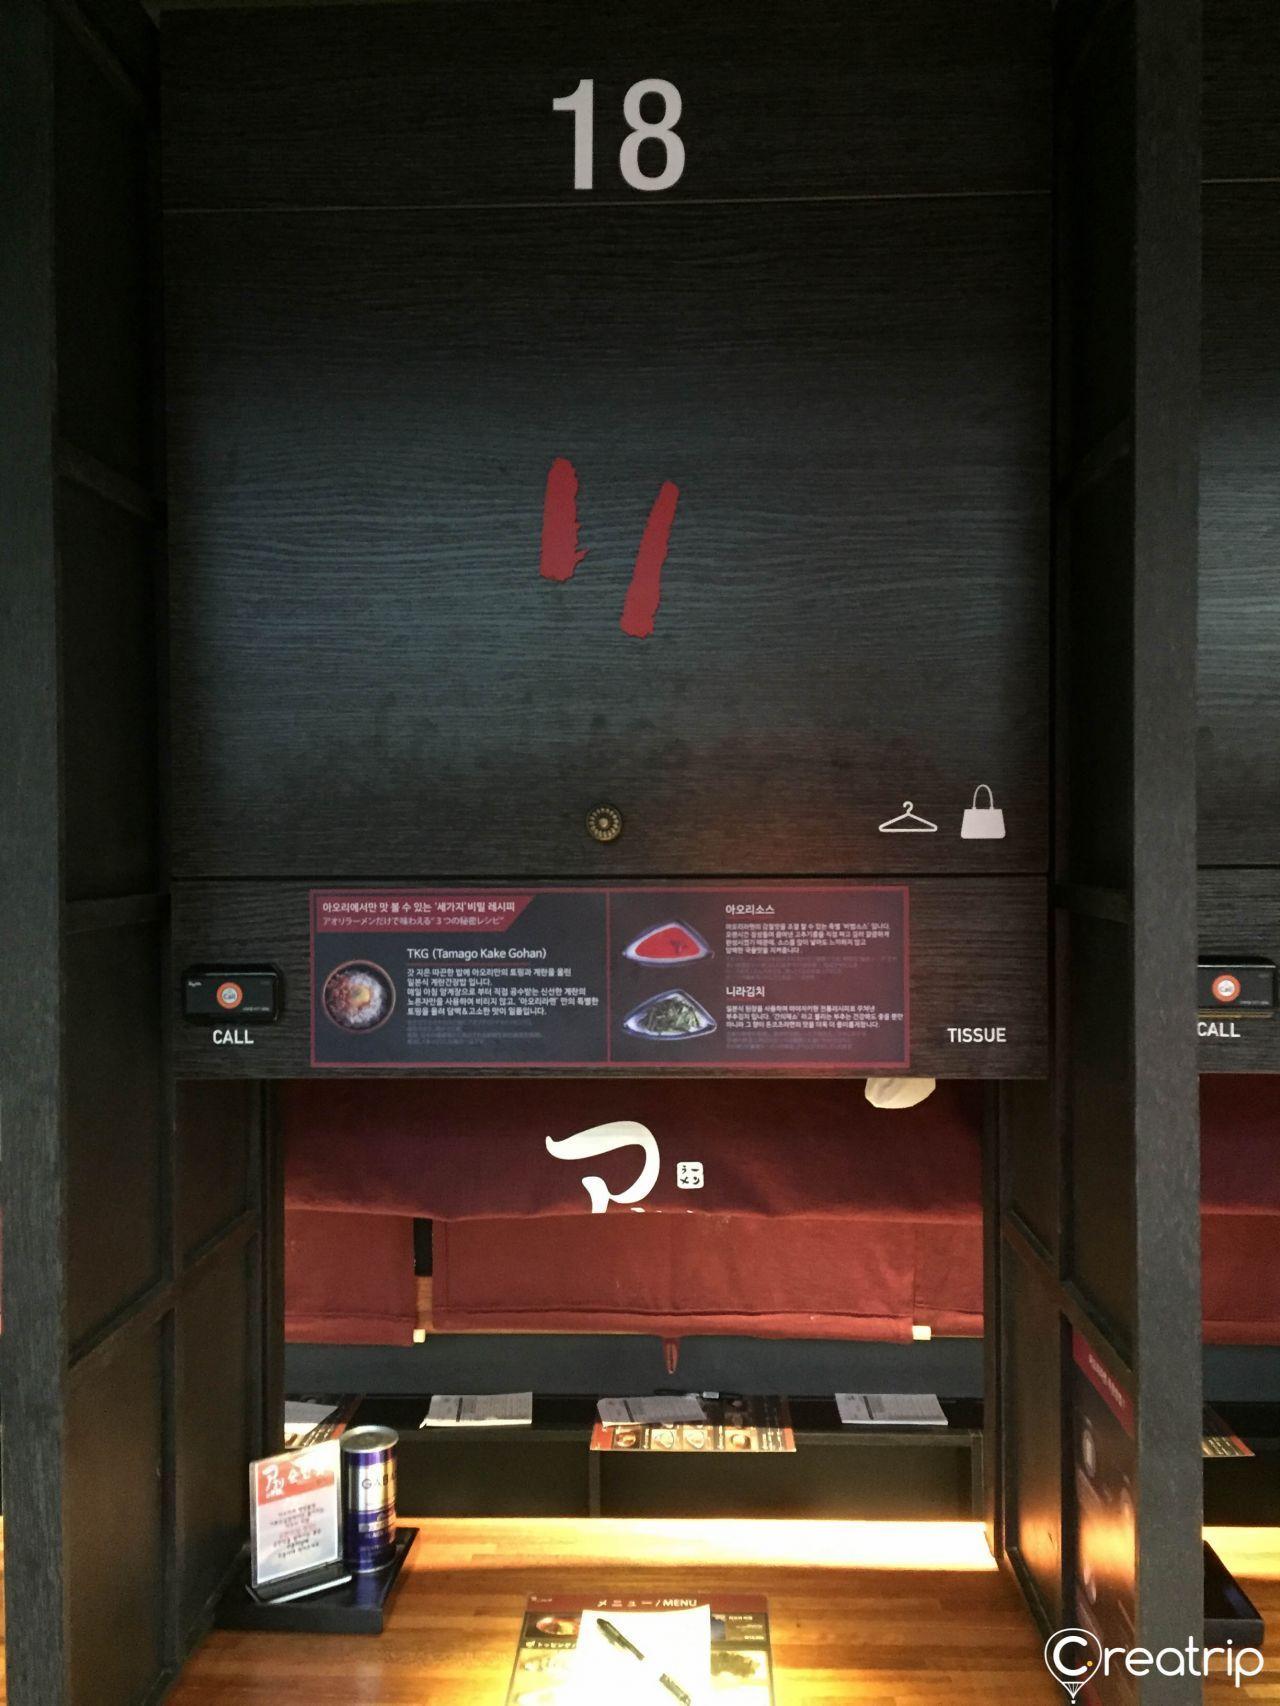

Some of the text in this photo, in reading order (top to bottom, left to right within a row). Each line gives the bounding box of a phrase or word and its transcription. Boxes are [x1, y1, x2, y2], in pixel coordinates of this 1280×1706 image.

[553, 78, 685, 191] 18
[323, 902, 377, 913] 아오리에서만
[380, 902, 388, 913] 맛
[402, 902, 411, 913] 수
[414, 902, 432, 913] 있는
[488, 902, 515, 913] 레시피
[726, 904, 776, 915] 아오리소스
[407, 948, 546, 961] TKG (Tamago Kake Gohan)
[726, 986, 765, 997] 니라김치
[947, 1027, 1007, 1043] TISSUE
[1196, 1021, 1241, 1037] CALL
[213, 1029, 254, 1045] CALL
[662, 1599, 698, 1607] MENU
